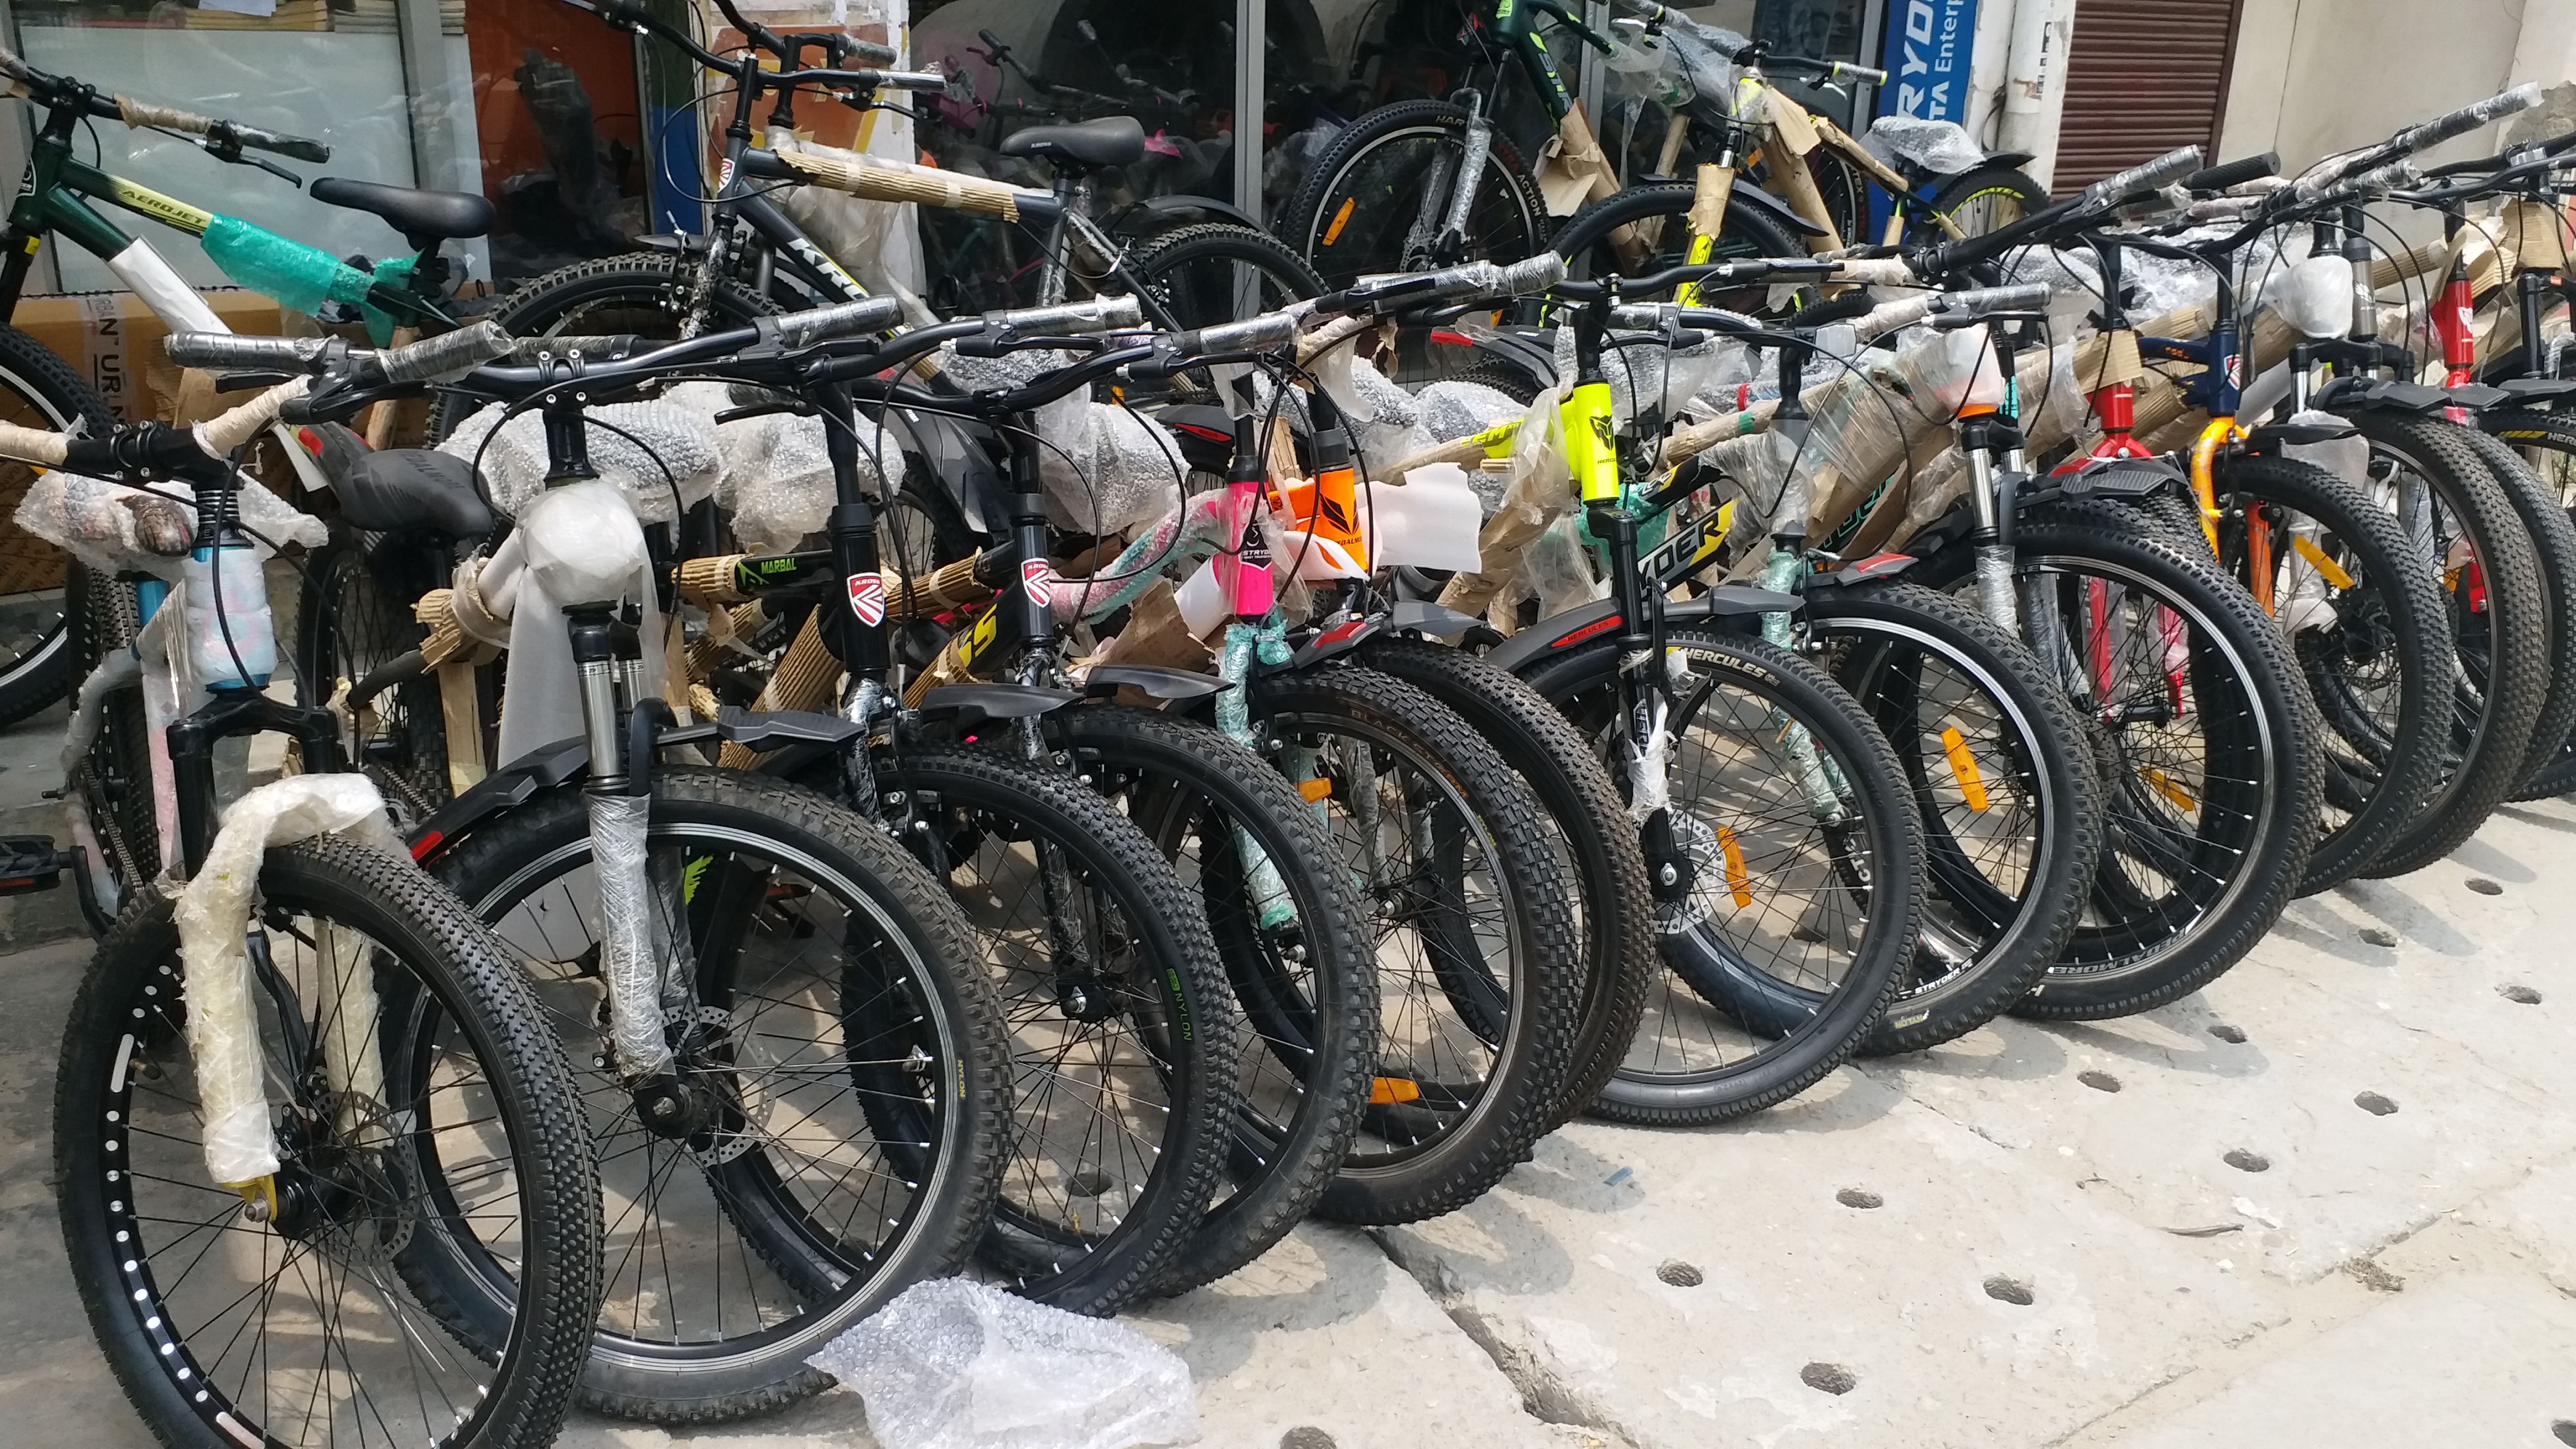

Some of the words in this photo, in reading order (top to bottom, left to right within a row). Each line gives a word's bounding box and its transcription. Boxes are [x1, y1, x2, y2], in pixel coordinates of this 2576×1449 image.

[1897, 0, 1934, 120] RYD
[1435, 115, 1469, 127] HAR
[1517, 174, 1542, 216] ACTION
[122, 190, 206, 224] AEROJET
[761, 558, 797, 575] MARBAL
[1568, 621, 1609, 642] HERCULES
[1683, 647, 1767, 678] HERCULES
[1350, 707, 1409, 742] BLACK
[2054, 926, 2187, 974] PEDALMORE
[1915, 967, 1961, 994] STRYDER
[1175, 992, 1192, 1041] NYLON
[957, 1059, 966, 1097] NYLON
